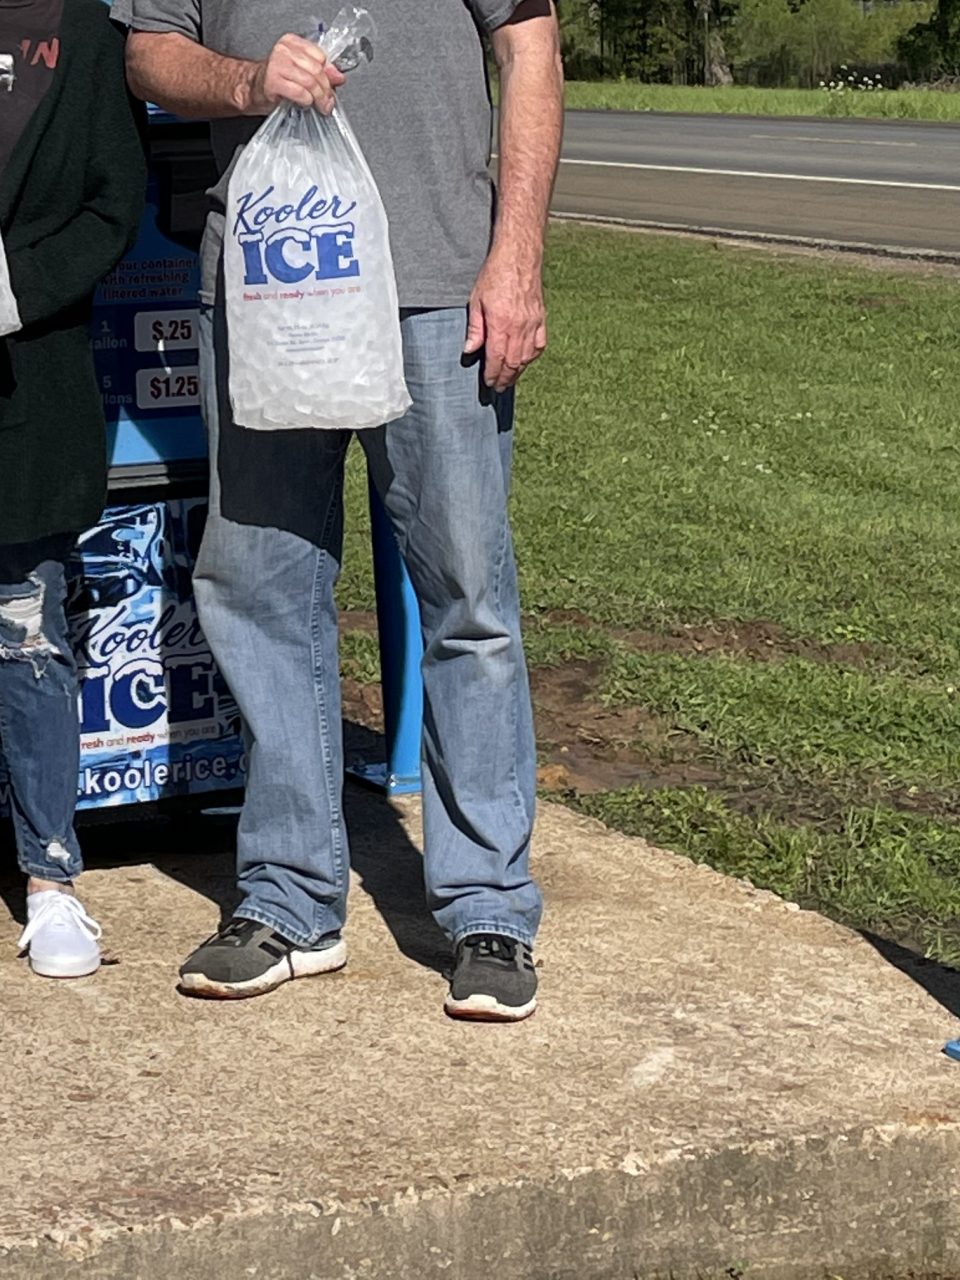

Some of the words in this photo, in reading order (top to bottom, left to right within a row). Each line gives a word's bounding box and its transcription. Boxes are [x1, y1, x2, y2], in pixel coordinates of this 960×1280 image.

[232, 184, 357, 237] Kooler
[237, 220, 361, 286] ICE
[148, 286, 184, 297] water
[102, 375, 112, 389] 5
[149, 375, 199, 400] $1.25
[74, 605, 207, 667] Kooler
[77, 651, 217, 732] ICE
[81, 737, 104, 750] resh
[106, 735, 125, 747] and
[126, 731, 156, 746] ready
